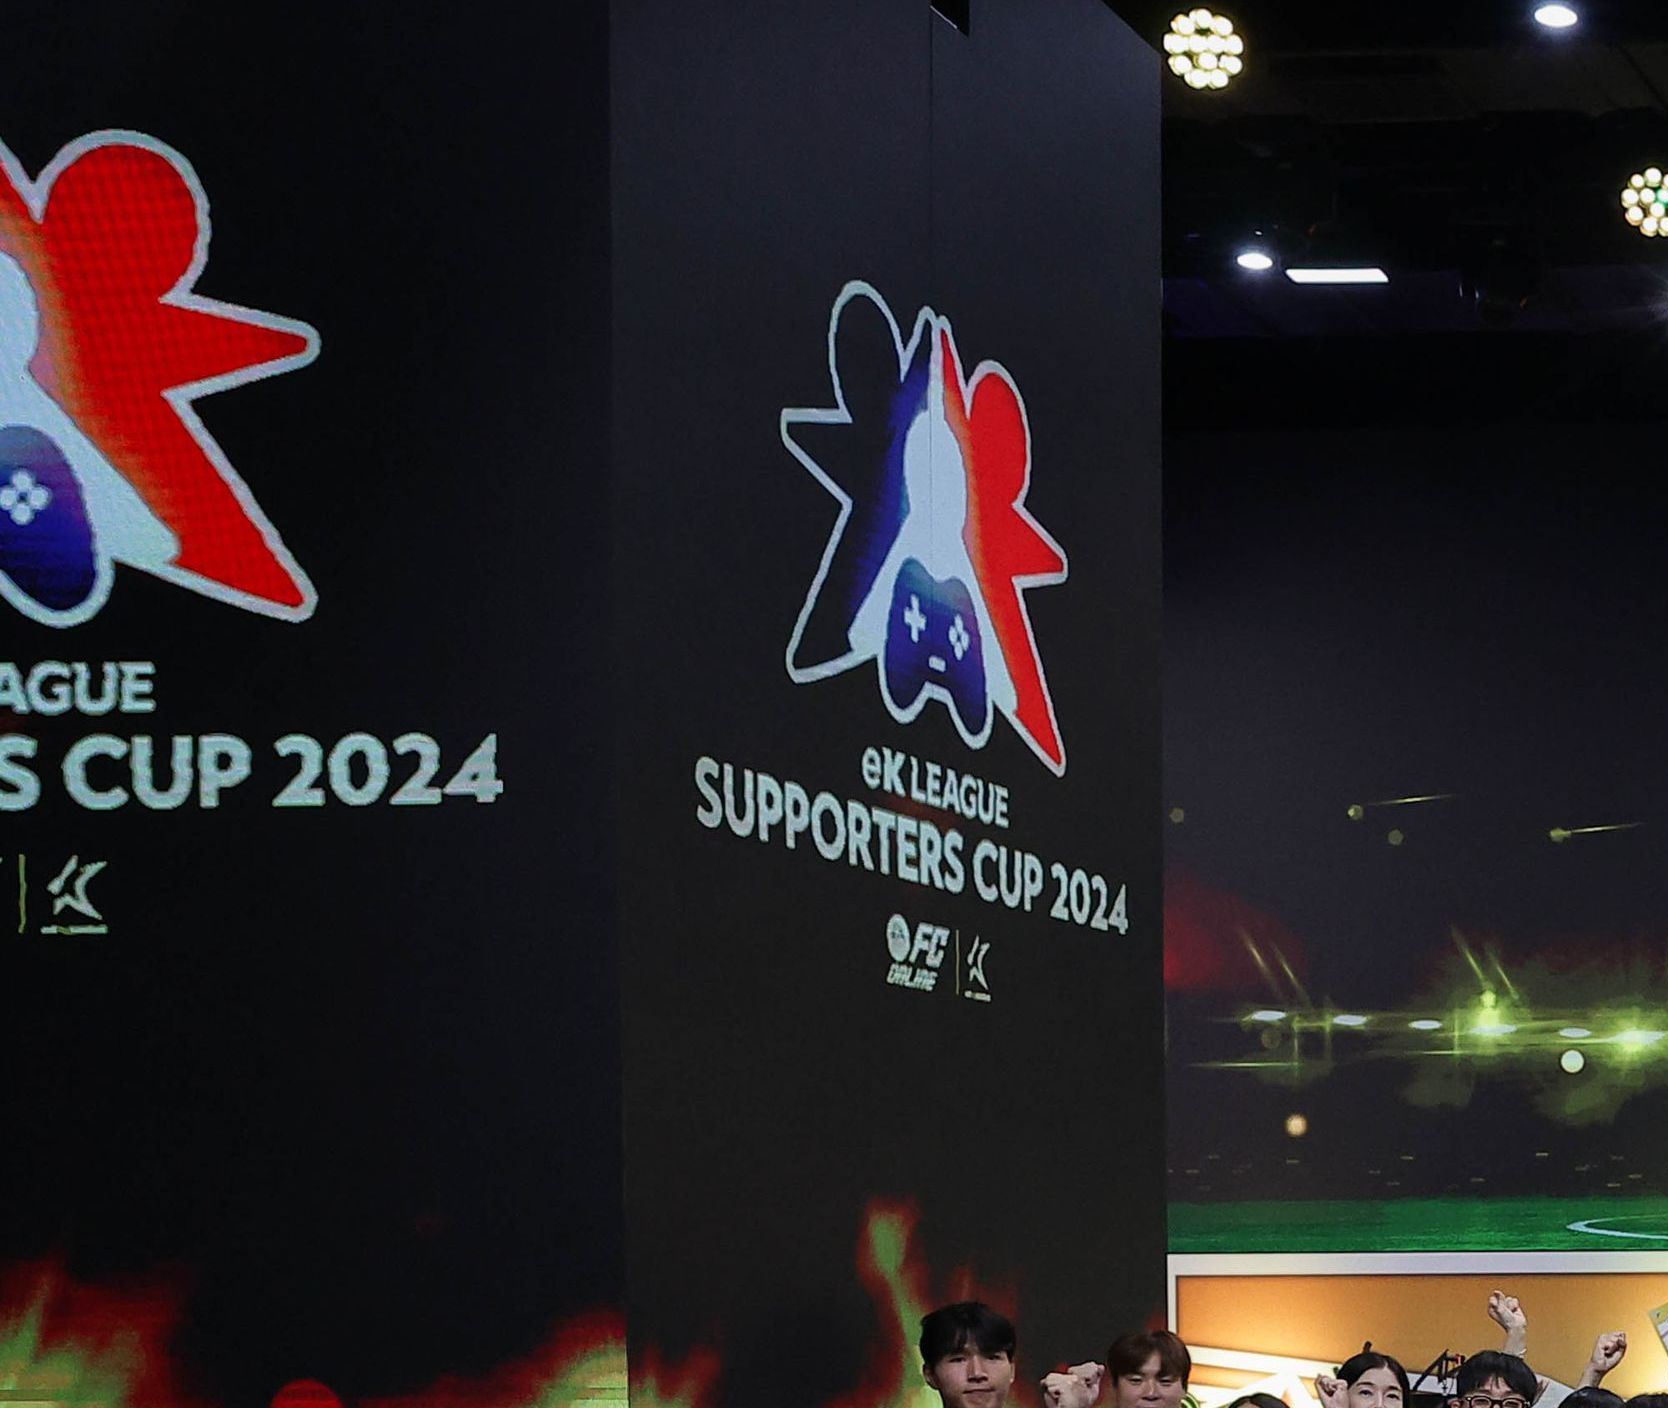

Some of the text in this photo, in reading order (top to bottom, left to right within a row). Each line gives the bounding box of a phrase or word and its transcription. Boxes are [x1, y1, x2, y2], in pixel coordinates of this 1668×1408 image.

[62, 733, 252, 810] CUP
[272, 732, 503, 807] 2024
[862, 746, 1010, 829] eK LEAGUE
[694, 756, 1129, 935] SUPPORTERS CUP 2024
